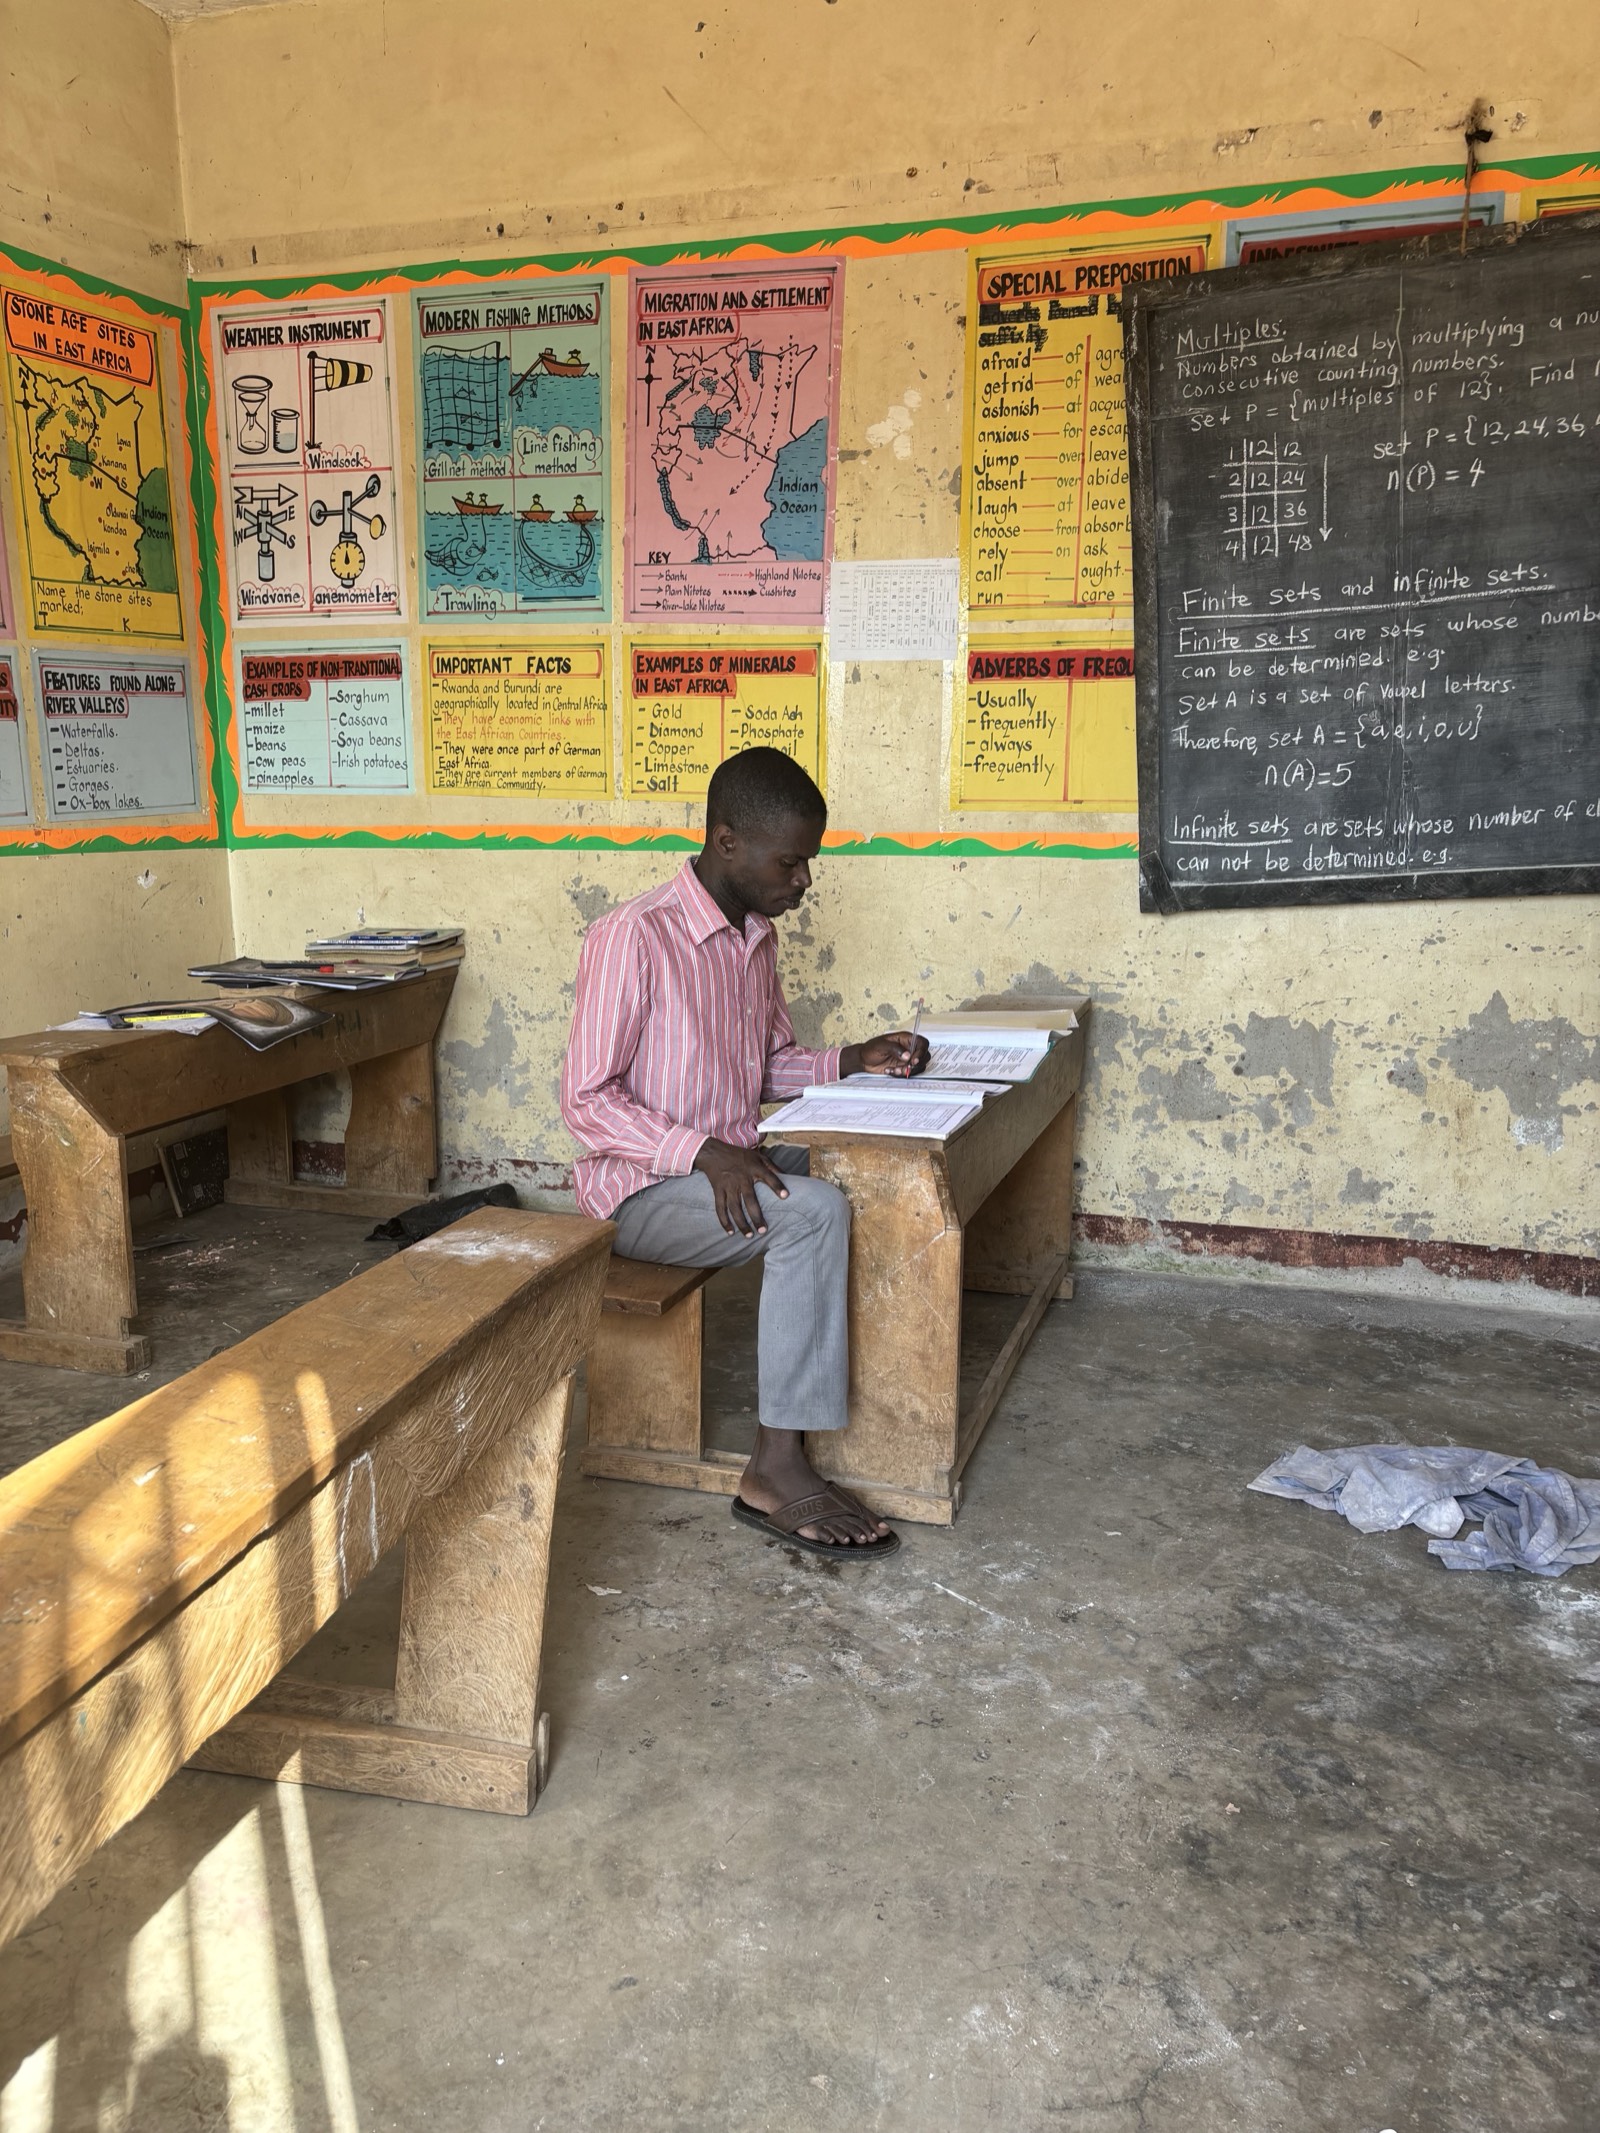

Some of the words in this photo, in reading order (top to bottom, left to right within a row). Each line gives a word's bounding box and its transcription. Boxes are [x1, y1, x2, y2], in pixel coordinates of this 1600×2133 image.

[988, 270, 1066, 298] SPECIAL
[1076, 255, 1191, 291] PREPOSITION
[645, 292, 718, 313] MIGRATION
[721, 290, 748, 310] AND
[752, 287, 830, 308] SETTLEMENT
[11, 297, 55, 325] STONE
[61, 311, 87, 333] AGE
[98, 324, 135, 348] SITES
[425, 309, 479, 332] MODERN
[486, 307, 530, 326] FISHING
[538, 303, 593, 324] METHODS
[225, 327, 283, 348] WEATHER
[288, 320, 371, 343] INSTRUMENT
[640, 322, 652, 340] IN
[658, 320, 687, 338] EAST
[689, 316, 734, 336] AFRICA
[34, 332, 47, 350] IN
[56, 338, 85, 361] EAST
[92, 348, 132, 373] AFRICA
[982, 350, 1031, 371] afraid
[1065, 343, 1083, 363] of
[1178, 353, 1257, 379] Numbers
[1271, 335, 1358, 363] obtained
[1372, 331, 1396, 360] by
[1412, 316, 1524, 347] multiplying
[1550, 317, 1562, 331] a
[1182, 368, 1299, 398] consecutive
[1318, 359, 1399, 388] counting
[1412, 350, 1504, 373] numbers.
[982, 399, 1039, 418] astonish
[1067, 397, 1082, 413] at
[978, 426, 1030, 443] anxious
[1063, 422, 1082, 438] for
[523, 437, 548, 455] Line
[552, 434, 596, 461] fishing
[1089, 441, 1127, 462] leave
[308, 452, 363, 469] Windsock
[535, 457, 577, 473] method
[974, 449, 1019, 475] jump
[779, 477, 818, 493] Indian
[977, 470, 1027, 491] absent
[1057, 476, 1081, 487] over
[1087, 467, 1129, 486] abide
[780, 501, 817, 513] Ocean
[978, 496, 1017, 524] laugh
[1058, 494, 1073, 512] at
[1087, 492, 1126, 510] leave
[142, 502, 167, 521] Indian
[147, 527, 170, 540] Ocean
[974, 522, 1020, 538] choose
[1056, 519, 1080, 534] from
[978, 541, 1008, 566] rely
[1056, 546, 1070, 557] on
[1084, 538, 1108, 556] ask
[649, 552, 671, 564] KEY
[755, 570, 789, 587] Highland
[976, 564, 1002, 582] call
[38, 582, 65, 598] Name
[76, 585, 90, 599] the
[95, 585, 122, 603] stone
[128, 591, 152, 607] sites
[241, 589, 300, 606] Windvane
[315, 585, 397, 604] anemometer
[977, 592, 1003, 604] run
[1082, 590, 1115, 602] care
[1183, 584, 1252, 613] Finite
[1269, 581, 1321, 605] sets
[1341, 576, 1373, 595] and
[1394, 566, 1473, 592] infinite
[1486, 563, 1548, 586] sets.
[40, 599, 83, 615] marked;
[440, 591, 498, 619] Trawling
[39, 612, 48, 626] T
[123, 618, 130, 632] K
[1180, 627, 1242, 652] Finite
[1255, 626, 1311, 649] sets
[1335, 627, 1366, 640] are
[1380, 619, 1426, 638] sets
[1447, 613, 1518, 630] whose
[246, 662, 304, 679] EXAMPLES
[307, 661, 318, 677] OF
[320, 658, 402, 677] NON-TRADITIONAL
[437, 657, 512, 674] IMPORTANT
[527, 656, 571, 674] FACTS
[637, 655, 703, 673] EXAMPLES
[710, 656, 724, 672] OF
[729, 656, 796, 673] MINERALS
[972, 658, 1050, 678] ADVERBS
[1057, 658, 1076, 676] OF
[1182, 666, 1215, 679] can
[1228, 659, 1255, 678] be
[44, 671, 100, 691] FEATURES
[110, 675, 141, 691] FOUND
[145, 675, 176, 692] ALONG
[245, 683, 268, 698] CASH
[272, 682, 302, 697] CROPS
[442, 679, 479, 693] Rwanda
[483, 680, 499, 693] and
[504, 680, 541, 693] Burundi
[545, 684, 562, 693] are
[636, 679, 648, 693] IN
[654, 678, 682, 693] EAST
[687, 678, 732, 693] AFRICA.
[46, 697, 77, 714] RIVER
[79, 697, 125, 713] VALLEYS
[433, 696, 499, 718] geographically
[506, 695, 538, 710] located
[543, 697, 550, 710] in
[553, 697, 581, 710] Central
[652, 703, 682, 719] Gold
[745, 704, 777, 721] Soda
[60, 722, 118, 738] Waterfalls.
[650, 722, 703, 738] Diamond
[741, 723, 804, 744] Phosphate
[980, 711, 1057, 738] frequently
[65, 742, 104, 757] Deltas.
[472, 745, 493, 755] were
[497, 746, 519, 755] once
[524, 742, 545, 762] part
[550, 742, 561, 755] of
[564, 742, 600, 756] German
[649, 740, 694, 762] Copper
[980, 732, 1032, 758] always
[67, 759, 119, 775] Estuaries.
[439, 756, 459, 768] East
[645, 756, 709, 774] Limestone
[69, 777, 113, 798] Gorges.
[647, 775, 678, 792] Salt
[71, 794, 110, 810] Ox-box
[115, 793, 142, 809] lakes.
[1174, 809, 1239, 839] Infinite
[1248, 814, 1289, 836] sets
[1304, 819, 1338, 835] are
[1344, 816, 1383, 837] sets
[1393, 810, 1454, 835] whose
[1469, 805, 1545, 830] number
[1554, 800, 1577, 821] of
